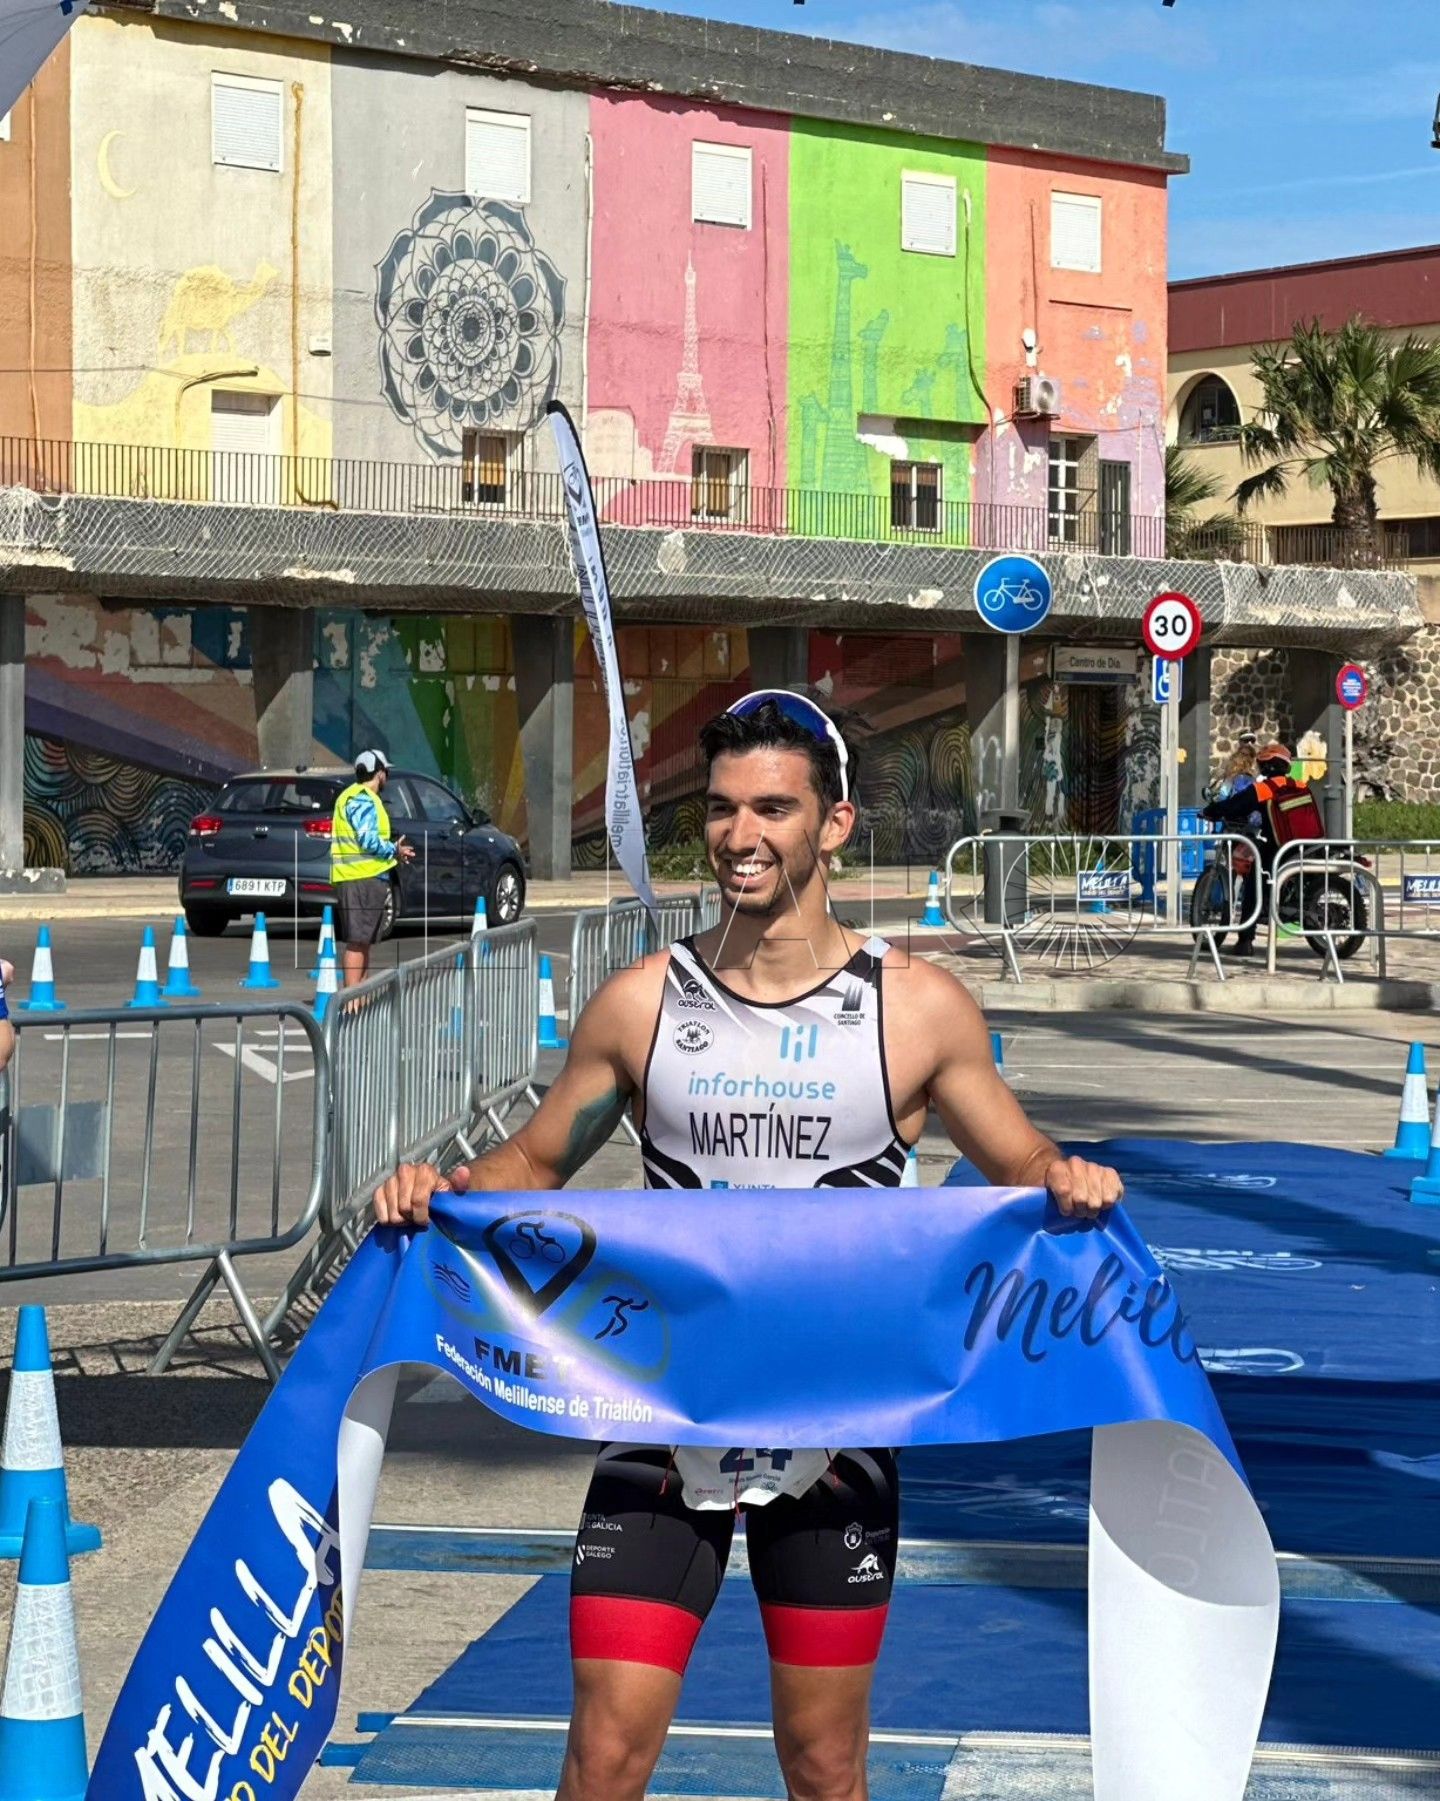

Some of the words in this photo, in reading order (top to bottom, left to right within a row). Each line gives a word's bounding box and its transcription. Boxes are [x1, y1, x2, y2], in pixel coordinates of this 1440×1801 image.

[1154, 614, 1187, 637] 30
[1070, 656, 1095, 668] Centro
[1096, 658, 1106, 668] de
[235, 880, 261, 892] 6891
[264, 881, 285, 892] KTP
[675, 1039, 710, 1053] SANTIAGO
[688, 1071, 837, 1100] inforhouse
[689, 1102, 832, 1161] MARTÍNEZ
[435, 1333, 492, 1393] Federación
[494, 1376, 565, 1416] Melillense
[568, 1394, 589, 1418] de
[594, 1396, 653, 1424] Triatlón
[591, 1522, 624, 1532] GALICIA
[585, 1551, 613, 1559] GALEGO
[586, 1545, 616, 1554] DEPORTE
[250, 1711, 299, 1784] DEL
